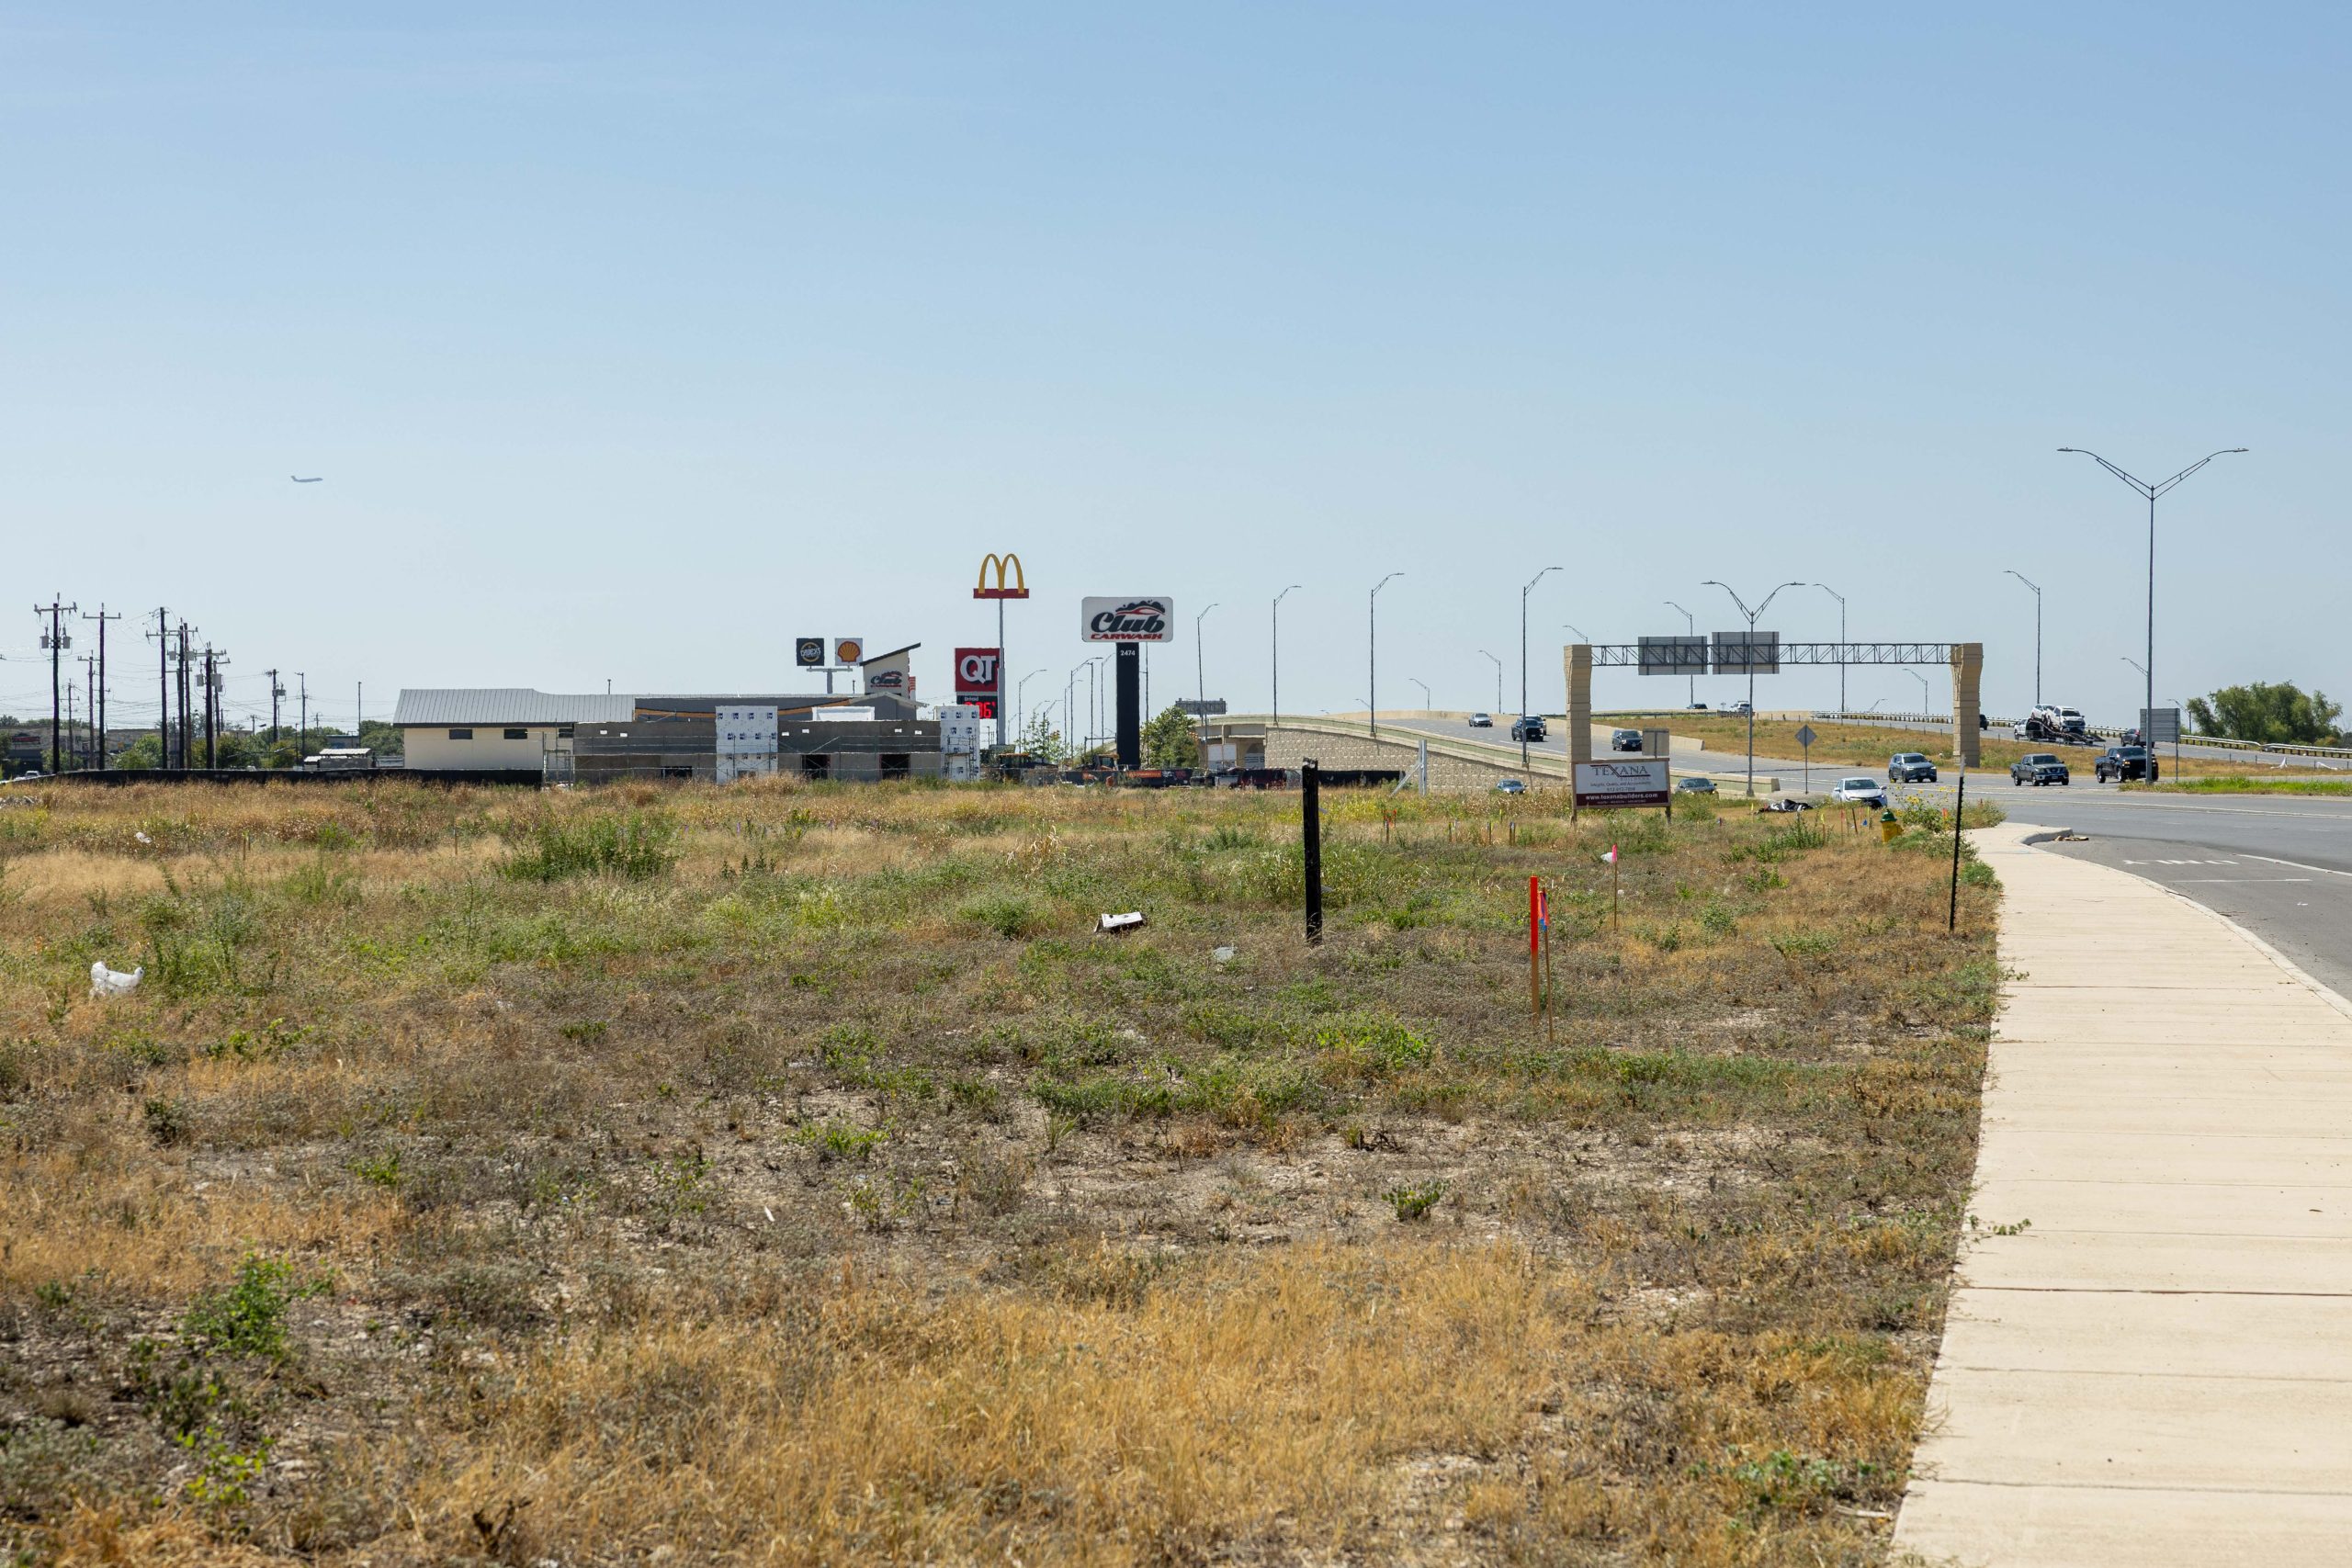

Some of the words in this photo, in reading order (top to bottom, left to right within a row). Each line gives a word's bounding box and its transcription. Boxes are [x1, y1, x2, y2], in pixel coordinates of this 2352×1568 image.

[1091, 612, 1165, 633] Club
[960, 655, 997, 684] QT
[1593, 765, 1647, 776] TEXANA
